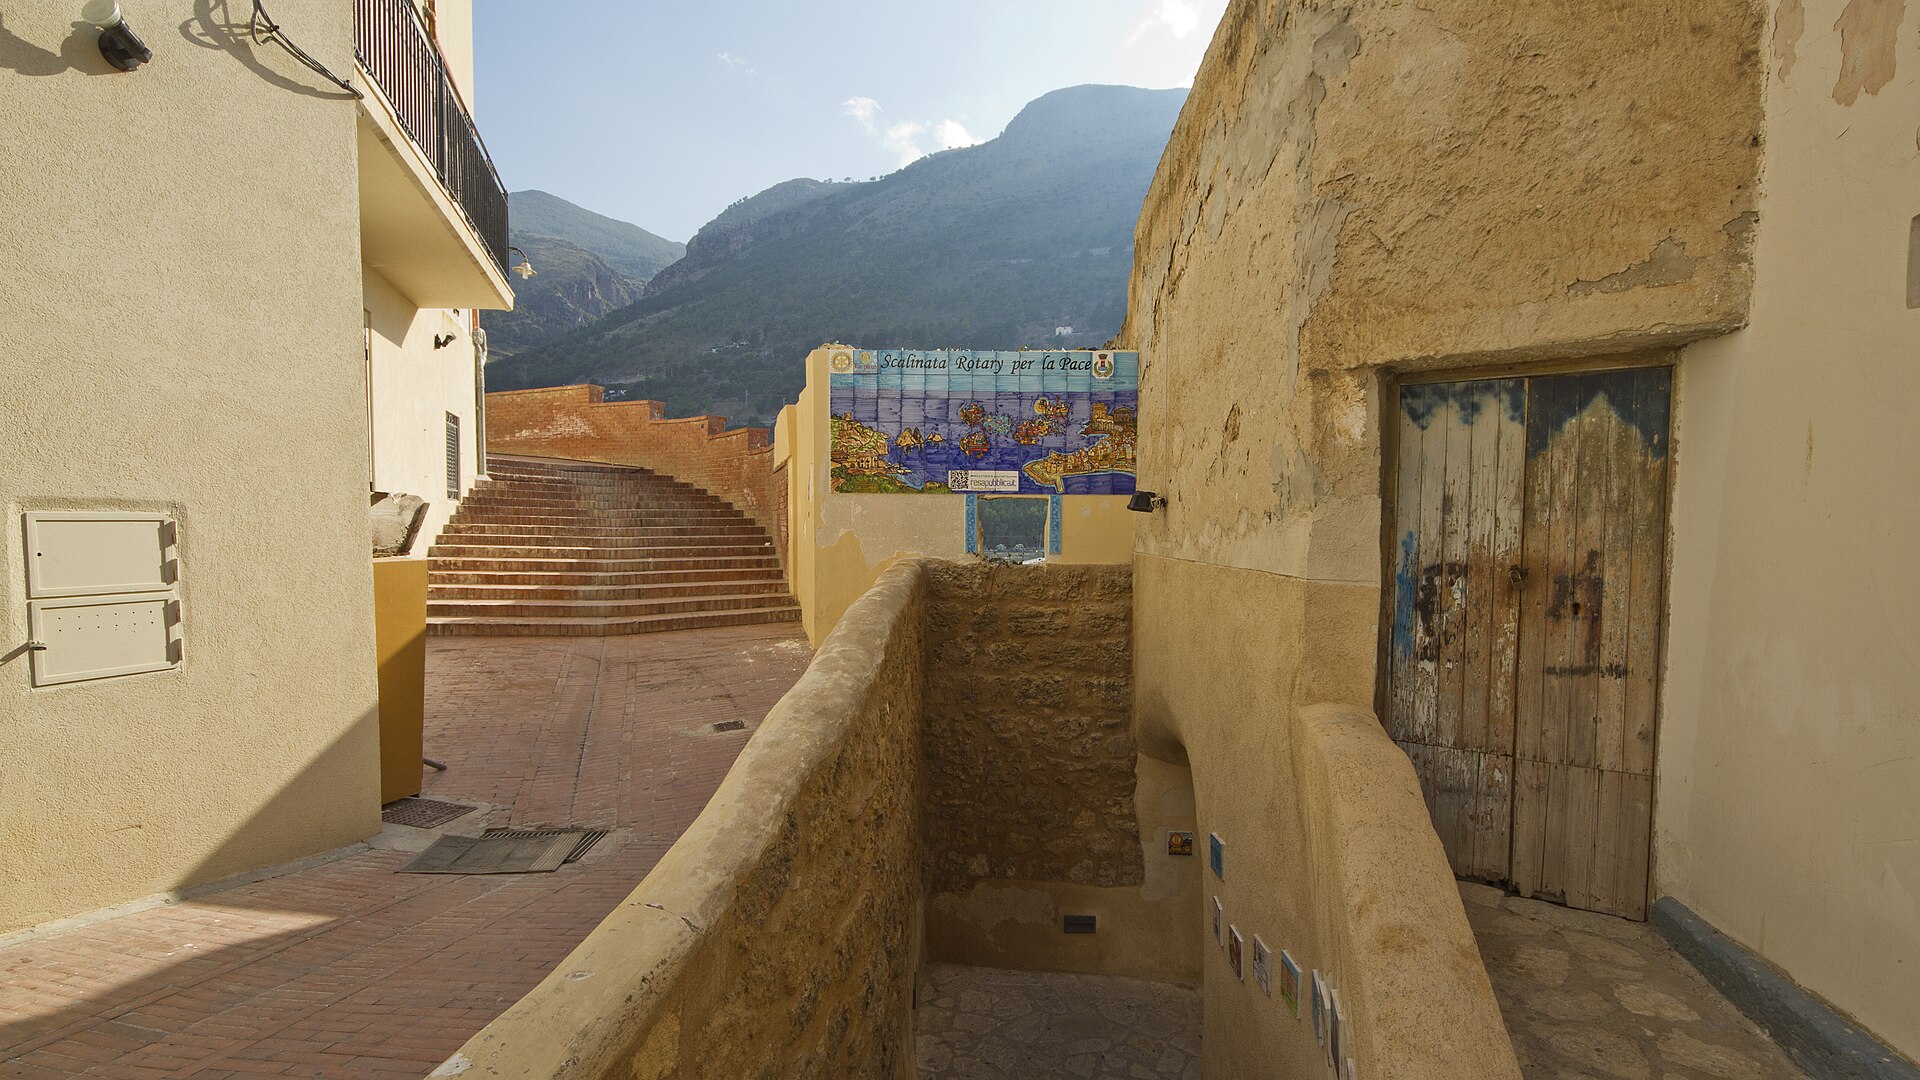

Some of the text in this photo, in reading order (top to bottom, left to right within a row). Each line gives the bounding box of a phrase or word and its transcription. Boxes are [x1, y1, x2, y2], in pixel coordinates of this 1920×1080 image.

[880, 353, 1092, 374] Scalinata Rotary per la Pace
